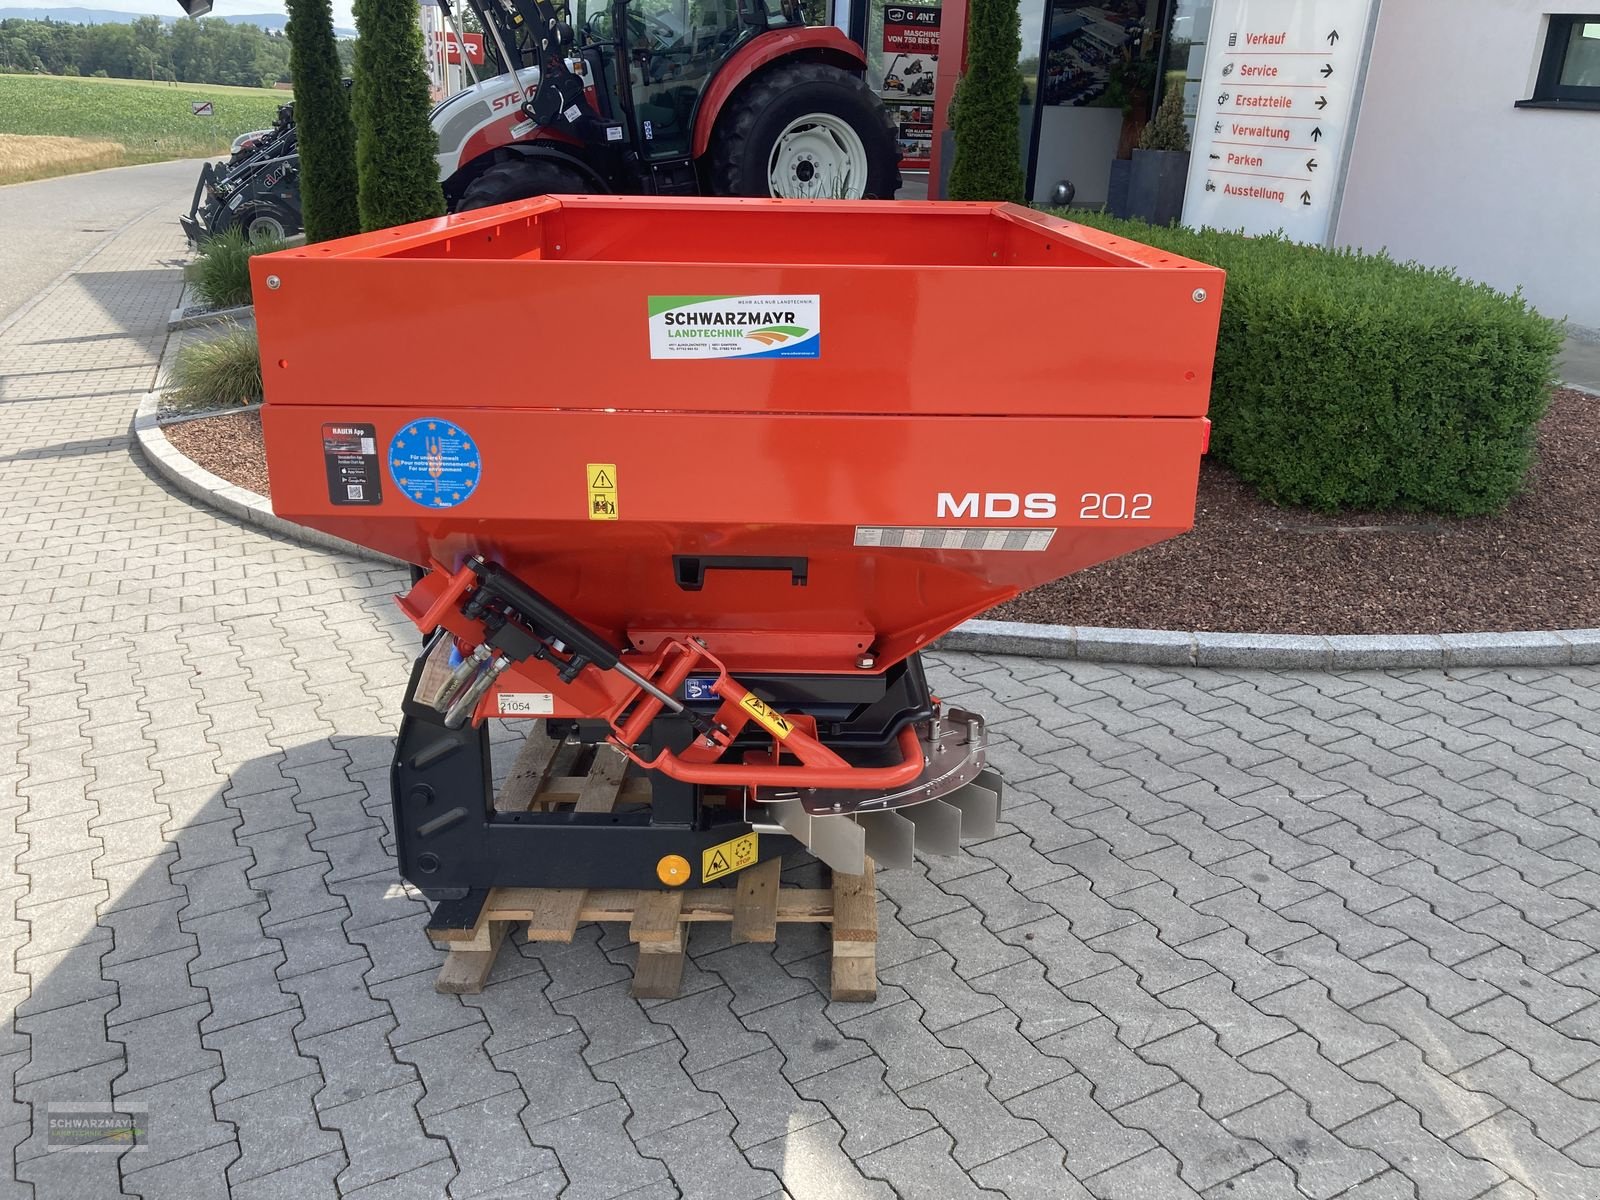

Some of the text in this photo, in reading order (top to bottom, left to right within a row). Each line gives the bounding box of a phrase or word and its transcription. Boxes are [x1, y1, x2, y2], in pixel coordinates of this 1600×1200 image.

[1246, 32, 1286, 45] Verkauf
[1240, 64, 1278, 76] Service
[1236, 94, 1292, 108] Ersatzteile
[1232, 124, 1290, 141] Verwaltung
[1227, 153, 1262, 167] Parken
[1224, 184, 1284, 202] Ausstellung
[664, 312, 796, 326] SCHWARZMAYR
[668, 329, 744, 338] LANDTECHNIK
[937, 492, 1152, 519] MDS 20.2
[736, 856, 751, 866] STOP
